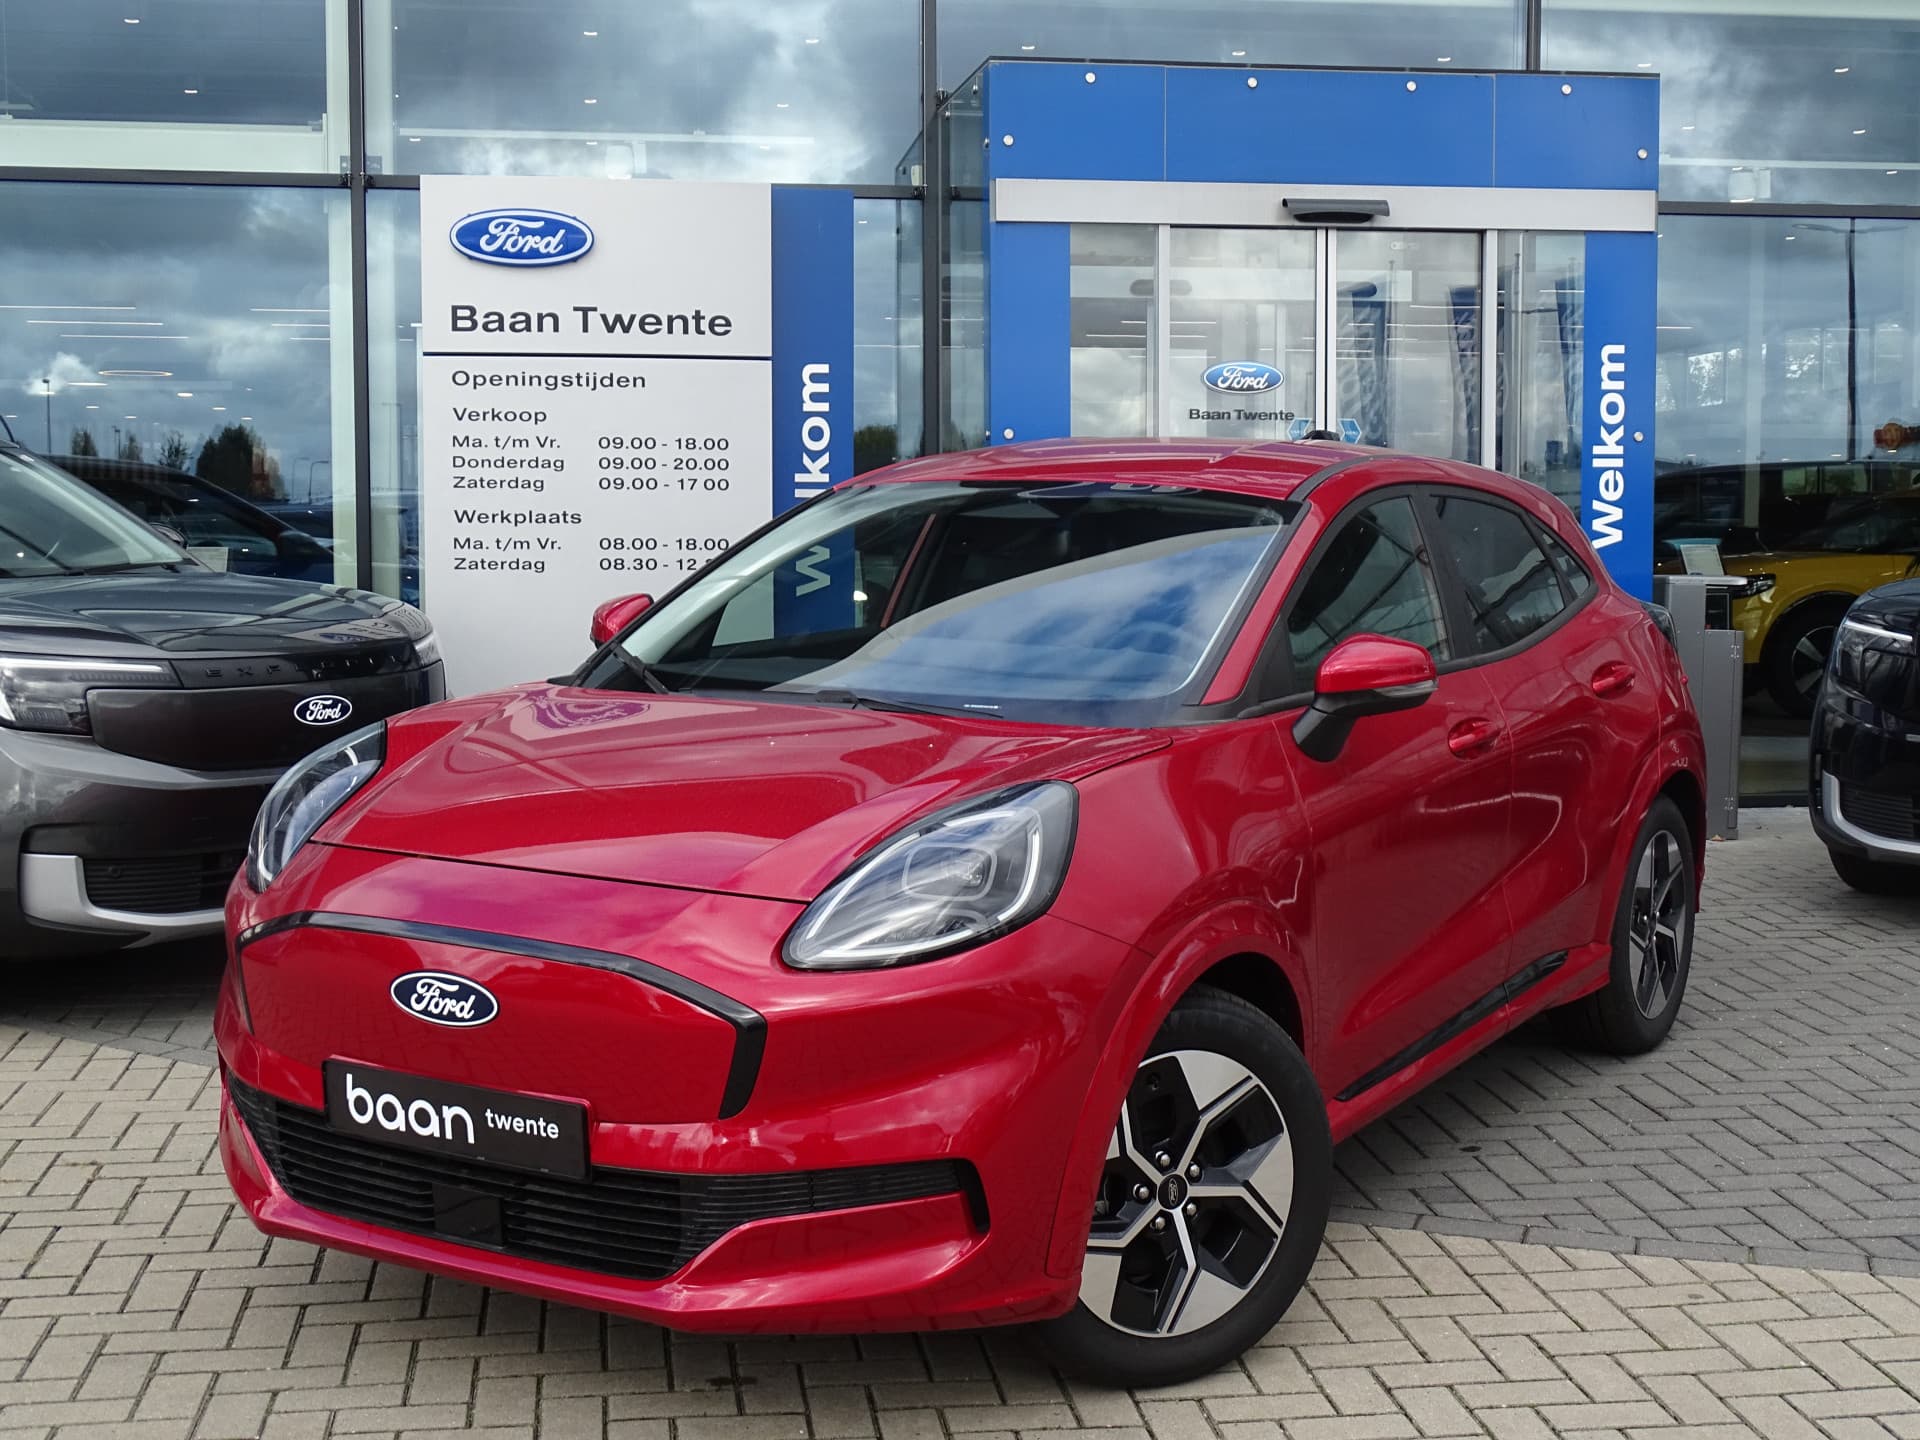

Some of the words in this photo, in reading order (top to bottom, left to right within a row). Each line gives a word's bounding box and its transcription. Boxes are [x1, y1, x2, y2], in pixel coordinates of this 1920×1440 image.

[479, 217, 567, 254] Ford
[451, 304, 560, 334] Baan
[572, 306, 733, 337] Twente
[451, 370, 646, 392] Openingstijden
[1216, 364, 1271, 390] Ford
[452, 407, 547, 426] Verkoop
[1188, 408, 1232, 421] Baan
[1233, 408, 1295, 422] Twente
[452, 435, 488, 448] Ma.
[493, 435, 529, 450] t/m
[535, 435, 561, 449] Vr.
[598, 436, 657, 450] 09.00
[674, 437, 729, 451] 18.00
[1590, 342, 1626, 551] Welkom
[452, 455, 565, 472] Donderdag
[598, 456, 657, 471] 09.00
[673, 457, 730, 471] 20.00
[452, 476, 545, 493] Zaterdag
[598, 477, 658, 491] 09.00
[453, 509, 582, 528] Werkplaats
[453, 537, 489, 550] Ma.
[495, 537, 531, 552] t/m
[536, 537, 561, 550] Vr.
[599, 537, 658, 551] 08.00
[674, 537, 730, 551] 18.00
[454, 557, 545, 574] Zaterdag
[599, 557, 658, 571] 08.30
[306, 700, 342, 721] Ford
[410, 978, 476, 1019] Ford
[346, 1073, 475, 1144] baan
[485, 1108, 559, 1139] twente
